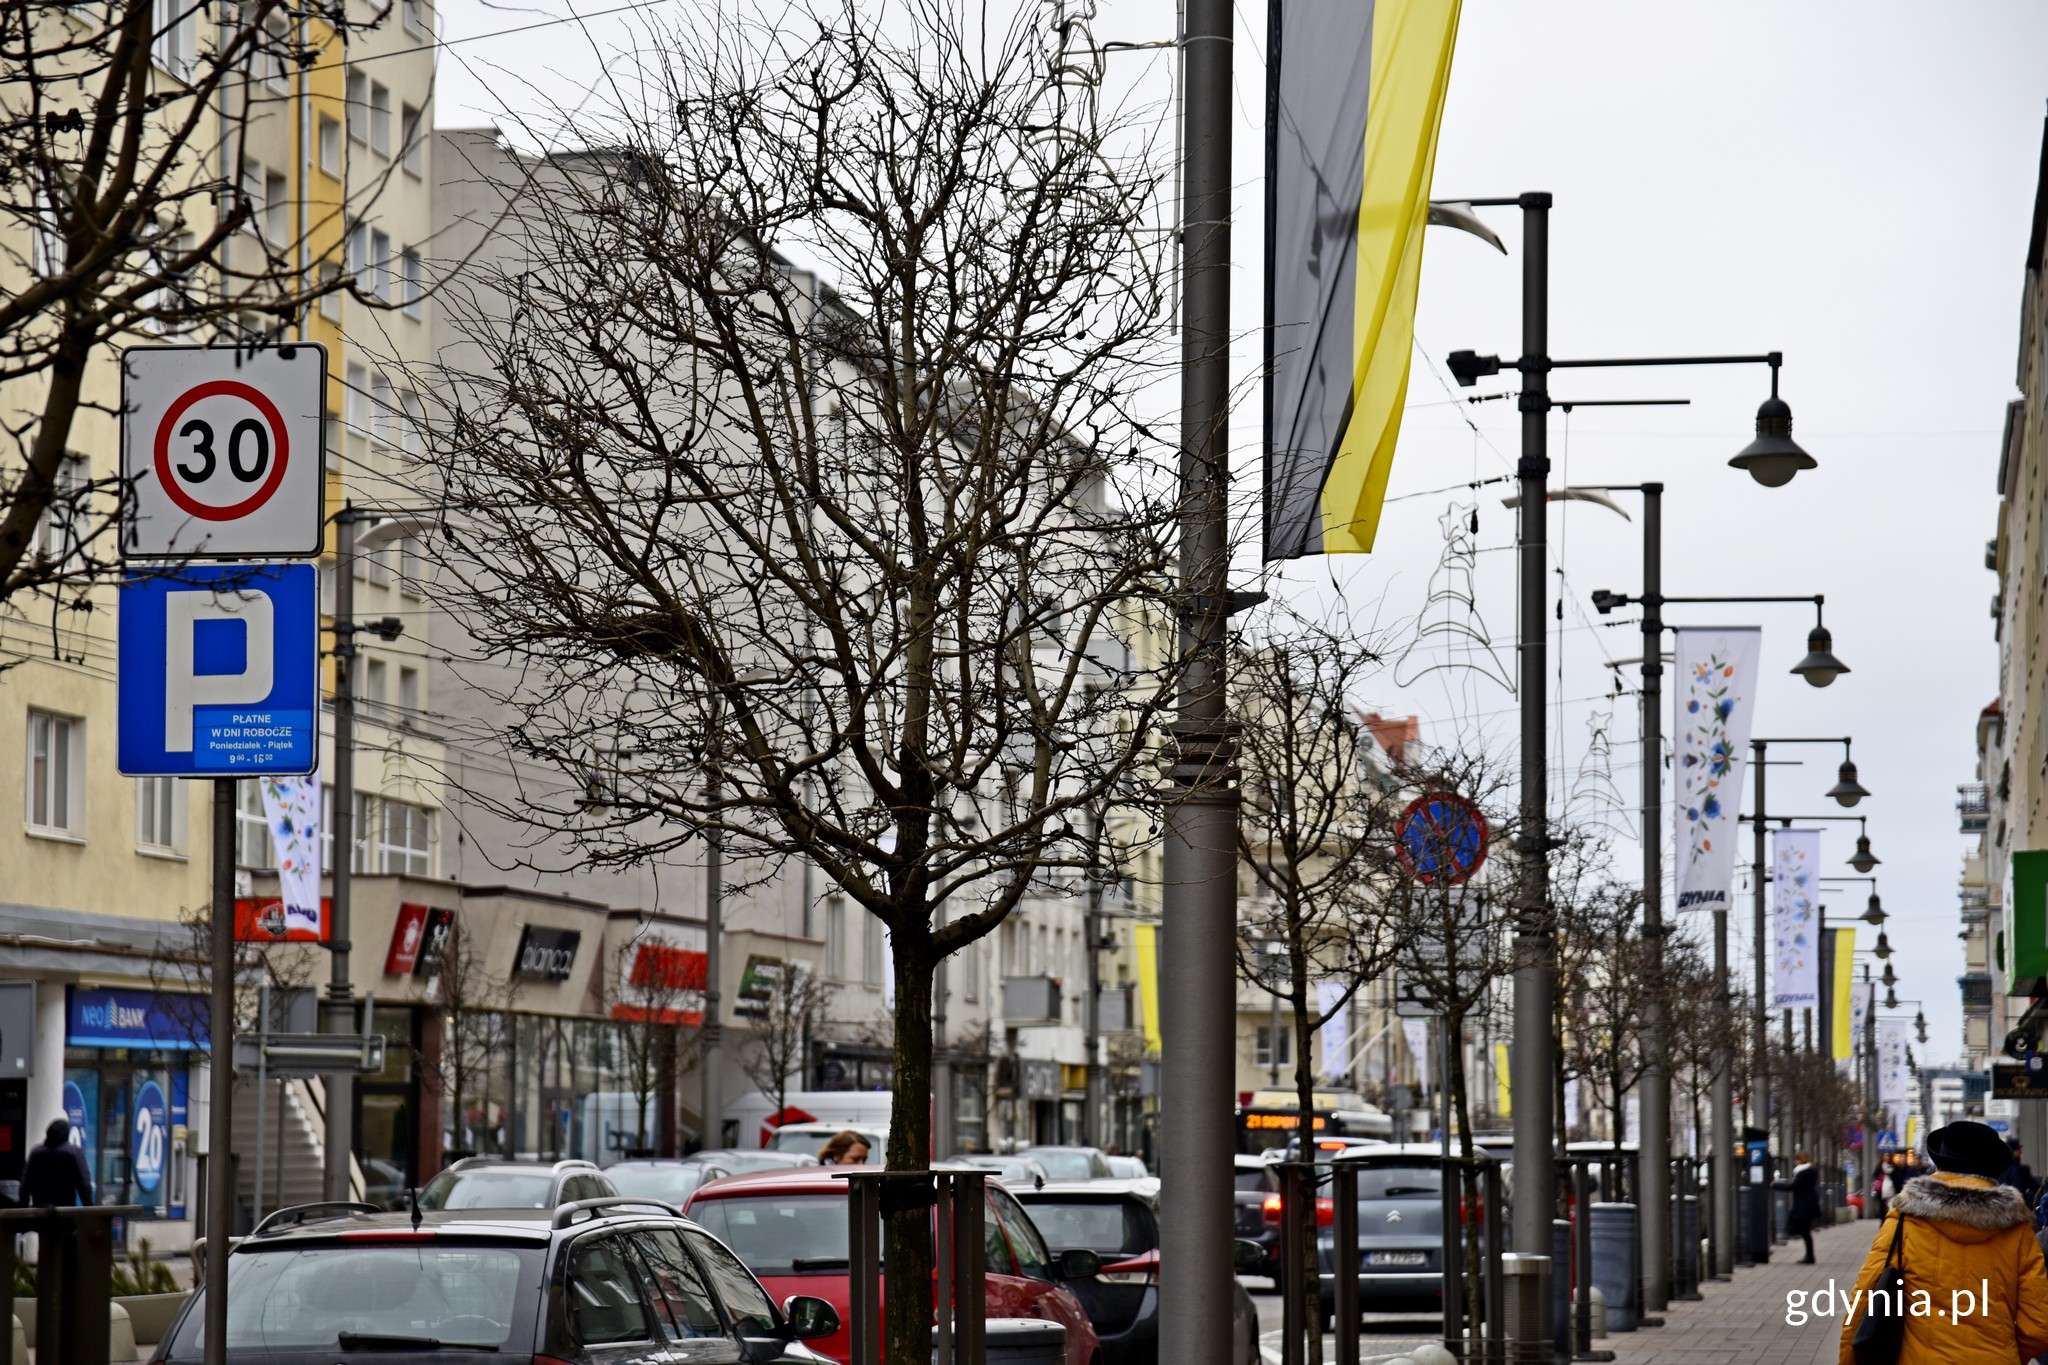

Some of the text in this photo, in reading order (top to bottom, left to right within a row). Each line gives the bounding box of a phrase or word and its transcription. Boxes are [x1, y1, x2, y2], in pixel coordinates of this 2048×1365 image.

[177, 418, 269, 484] 30
[165, 589, 274, 752] P
[232, 714, 271, 724] PŁATNE
[211, 727, 292, 737] W DNI ROBOCZE
[210, 741, 261, 750] Poniedziałek
[268, 741, 293, 750] Piątek
[1678, 890, 1726, 908] GDYNIA
[118, 1007, 146, 1029] BANK
